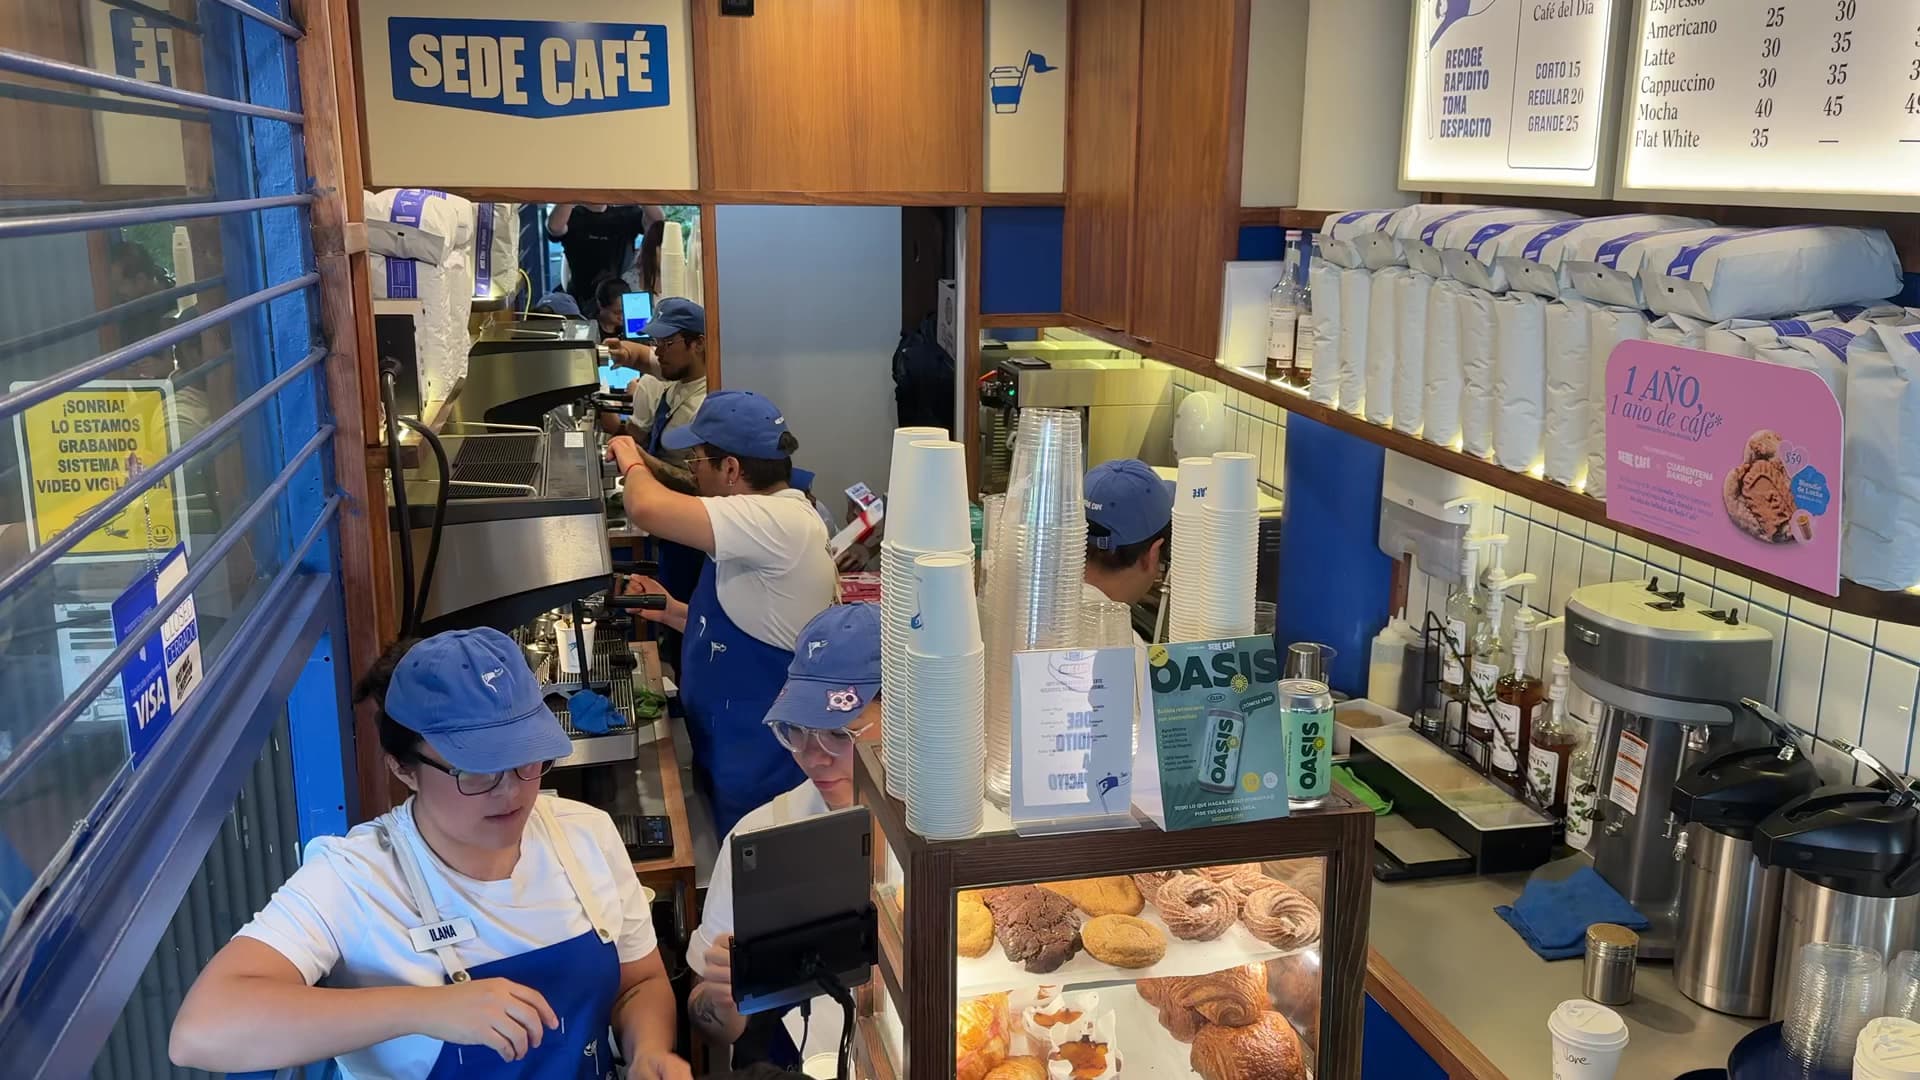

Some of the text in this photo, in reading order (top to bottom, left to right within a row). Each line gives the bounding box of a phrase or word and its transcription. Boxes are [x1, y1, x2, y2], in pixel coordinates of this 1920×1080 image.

[1533, 0, 1594, 21] Café del Día
[1646, 0, 1856, 40] Americano 25 30
[1445, 46, 1484, 70] RECOGE
[1644, 31, 1853, 67] Latte 30 35
[408, 30, 652, 106] SEDE CAFÉ
[1535, 61, 1582, 80] CORTO 15
[1640, 58, 1920, 96] Cappuccino 30 35 3
[1443, 69, 1490, 93] RAPIDITO
[1442, 95, 1467, 115] TOMA
[1527, 88, 1585, 106] REGULAR 20
[1638, 103, 1678, 121] Mocha
[1754, 98, 1773, 119] 40
[1823, 95, 1845, 117] 45
[1440, 118, 1491, 138] DESPACITO
[1528, 115, 1580, 132] GRANDE 25
[1634, 128, 1770, 149] Flat White 35
[1624, 365, 1704, 417] 1 AÑO,
[1611, 393, 1619, 416] 1
[1656, 402, 1677, 429] de
[51, 418, 141, 434] LO ESTAMOS
[58, 438, 138, 454] GRABANDO
[57, 457, 120, 473] SISTEMA
[166, 619, 198, 667] CERRADO
[1150, 648, 1280, 694] OASIS
[132, 676, 167, 730] VISA
[1211, 719, 1234, 784] OASIS
[1300, 721, 1320, 790] OASIS
[429, 925, 457, 942] ILANA
